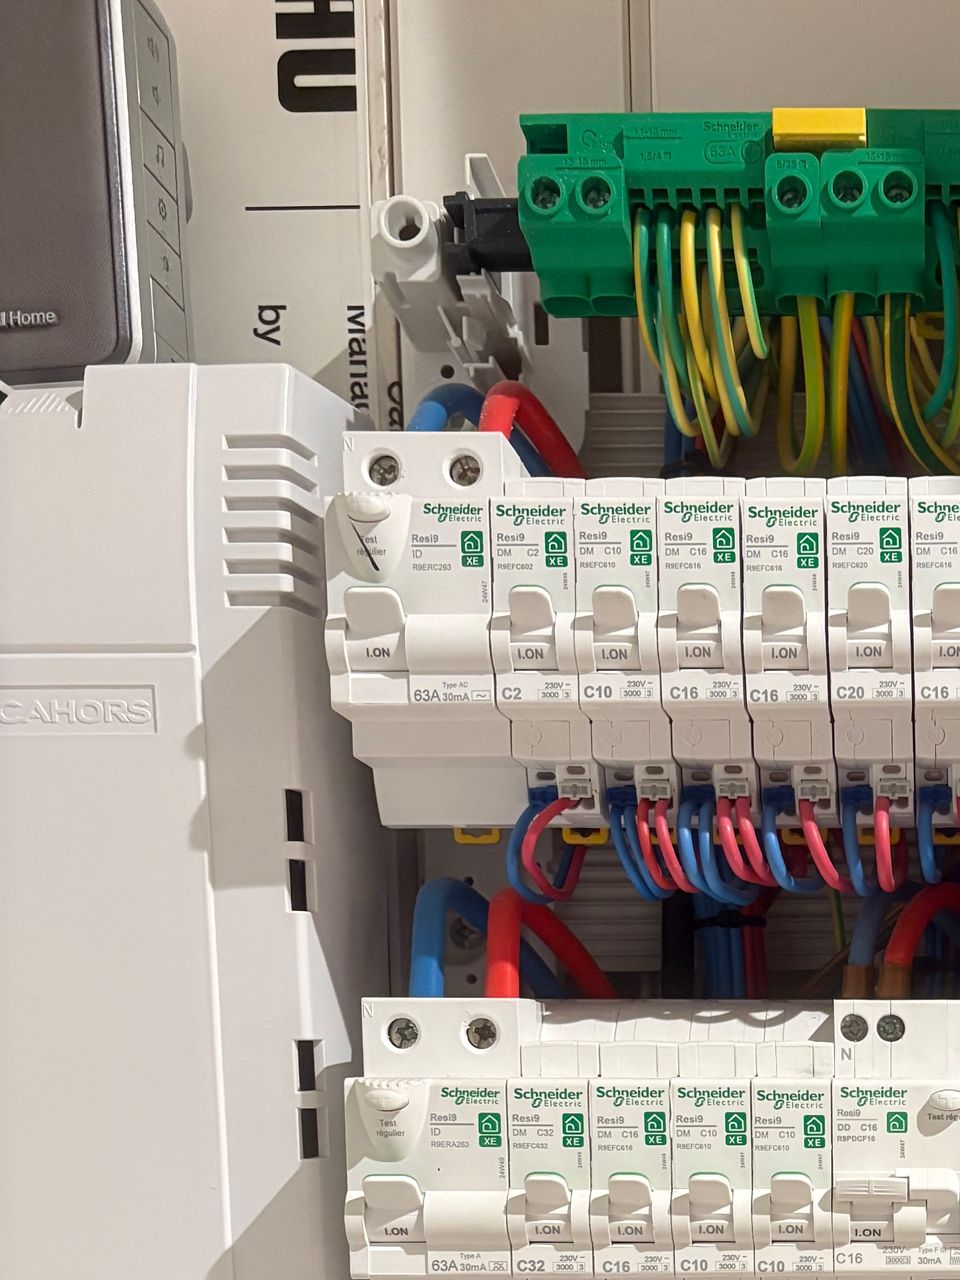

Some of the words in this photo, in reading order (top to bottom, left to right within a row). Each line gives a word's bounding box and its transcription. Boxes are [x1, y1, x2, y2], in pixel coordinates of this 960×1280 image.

[9, 311, 56, 326] Home
[253, 305, 287, 346] by
[423, 503, 483, 516] Schneider
[496, 505, 566, 518] Schneider
[580, 503, 651, 516] Schneider
[664, 502, 734, 514] Schneider
[748, 506, 818, 519] Schneider
[831, 501, 901, 514] Schneider
[449, 515, 482, 523] Electric
[694, 514, 733, 522] Electric
[411, 534, 439, 543] Resi9
[496, 533, 525, 542] Resi9
[665, 532, 693, 541] Resi9
[831, 532, 860, 541] Resi9
[665, 548, 679, 556] DM
[689, 548, 707, 556] C16
[832, 547, 847, 556] DM
[857, 547, 874, 555] C20
[883, 553, 898, 561] XE
[466, 556, 479, 566] XE
[549, 557, 564, 566] XE
[717, 553, 731, 562] XE
[366, 648, 390, 658] I.ON
[518, 649, 544, 660] I.ON
[602, 649, 628, 660] I.ON
[685, 647, 711, 658] I.ON
[771, 648, 798, 658] I.ON
[856, 646, 882, 657] I.ON
[413, 689, 440, 701] 63A
[442, 692, 470, 701] 30mA
[501, 687, 522, 700] C2
[584, 686, 612, 698] C10
[670, 687, 698, 699] C16
[749, 689, 778, 702] C16
[836, 686, 865, 699] C20
[920, 686, 949, 699] C16
[0, 700, 151, 724] CAHORS
[841, 1047, 852, 1061] N
[441, 1087, 500, 1099] Schneider
[514, 1088, 583, 1100] Schneider
[596, 1086, 665, 1098] Schneider
[677, 1087, 746, 1099] Schneider
[757, 1090, 825, 1102] Schneider
[840, 1086, 908, 1099] Schneider
[544, 1100, 582, 1108] Electric
[430, 1113, 457, 1122] Resi9
[512, 1114, 540, 1123] Resi9
[676, 1115, 704, 1123] Resi9
[431, 1128, 441, 1136] ID
[537, 1128, 554, 1136] C32
[484, 1137, 497, 1145] XE
[566, 1137, 580, 1145] XE
[729, 1136, 743, 1144] XE
[384, 1227, 408, 1236] I.ON
[535, 1225, 561, 1235] I.ON
[617, 1226, 643, 1236] I.ON
[698, 1225, 724, 1235] I.ON
[778, 1225, 804, 1234] I.ON
[854, 1229, 882, 1237] I.ON
[836, 1252, 863, 1264] C16
[431, 1260, 458, 1272] 63A
[460, 1263, 487, 1272] 30mA
[516, 1260, 545, 1272] C32
[602, 1261, 630, 1273] C16
[680, 1260, 708, 1272] C10
[757, 1261, 785, 1273] C10
